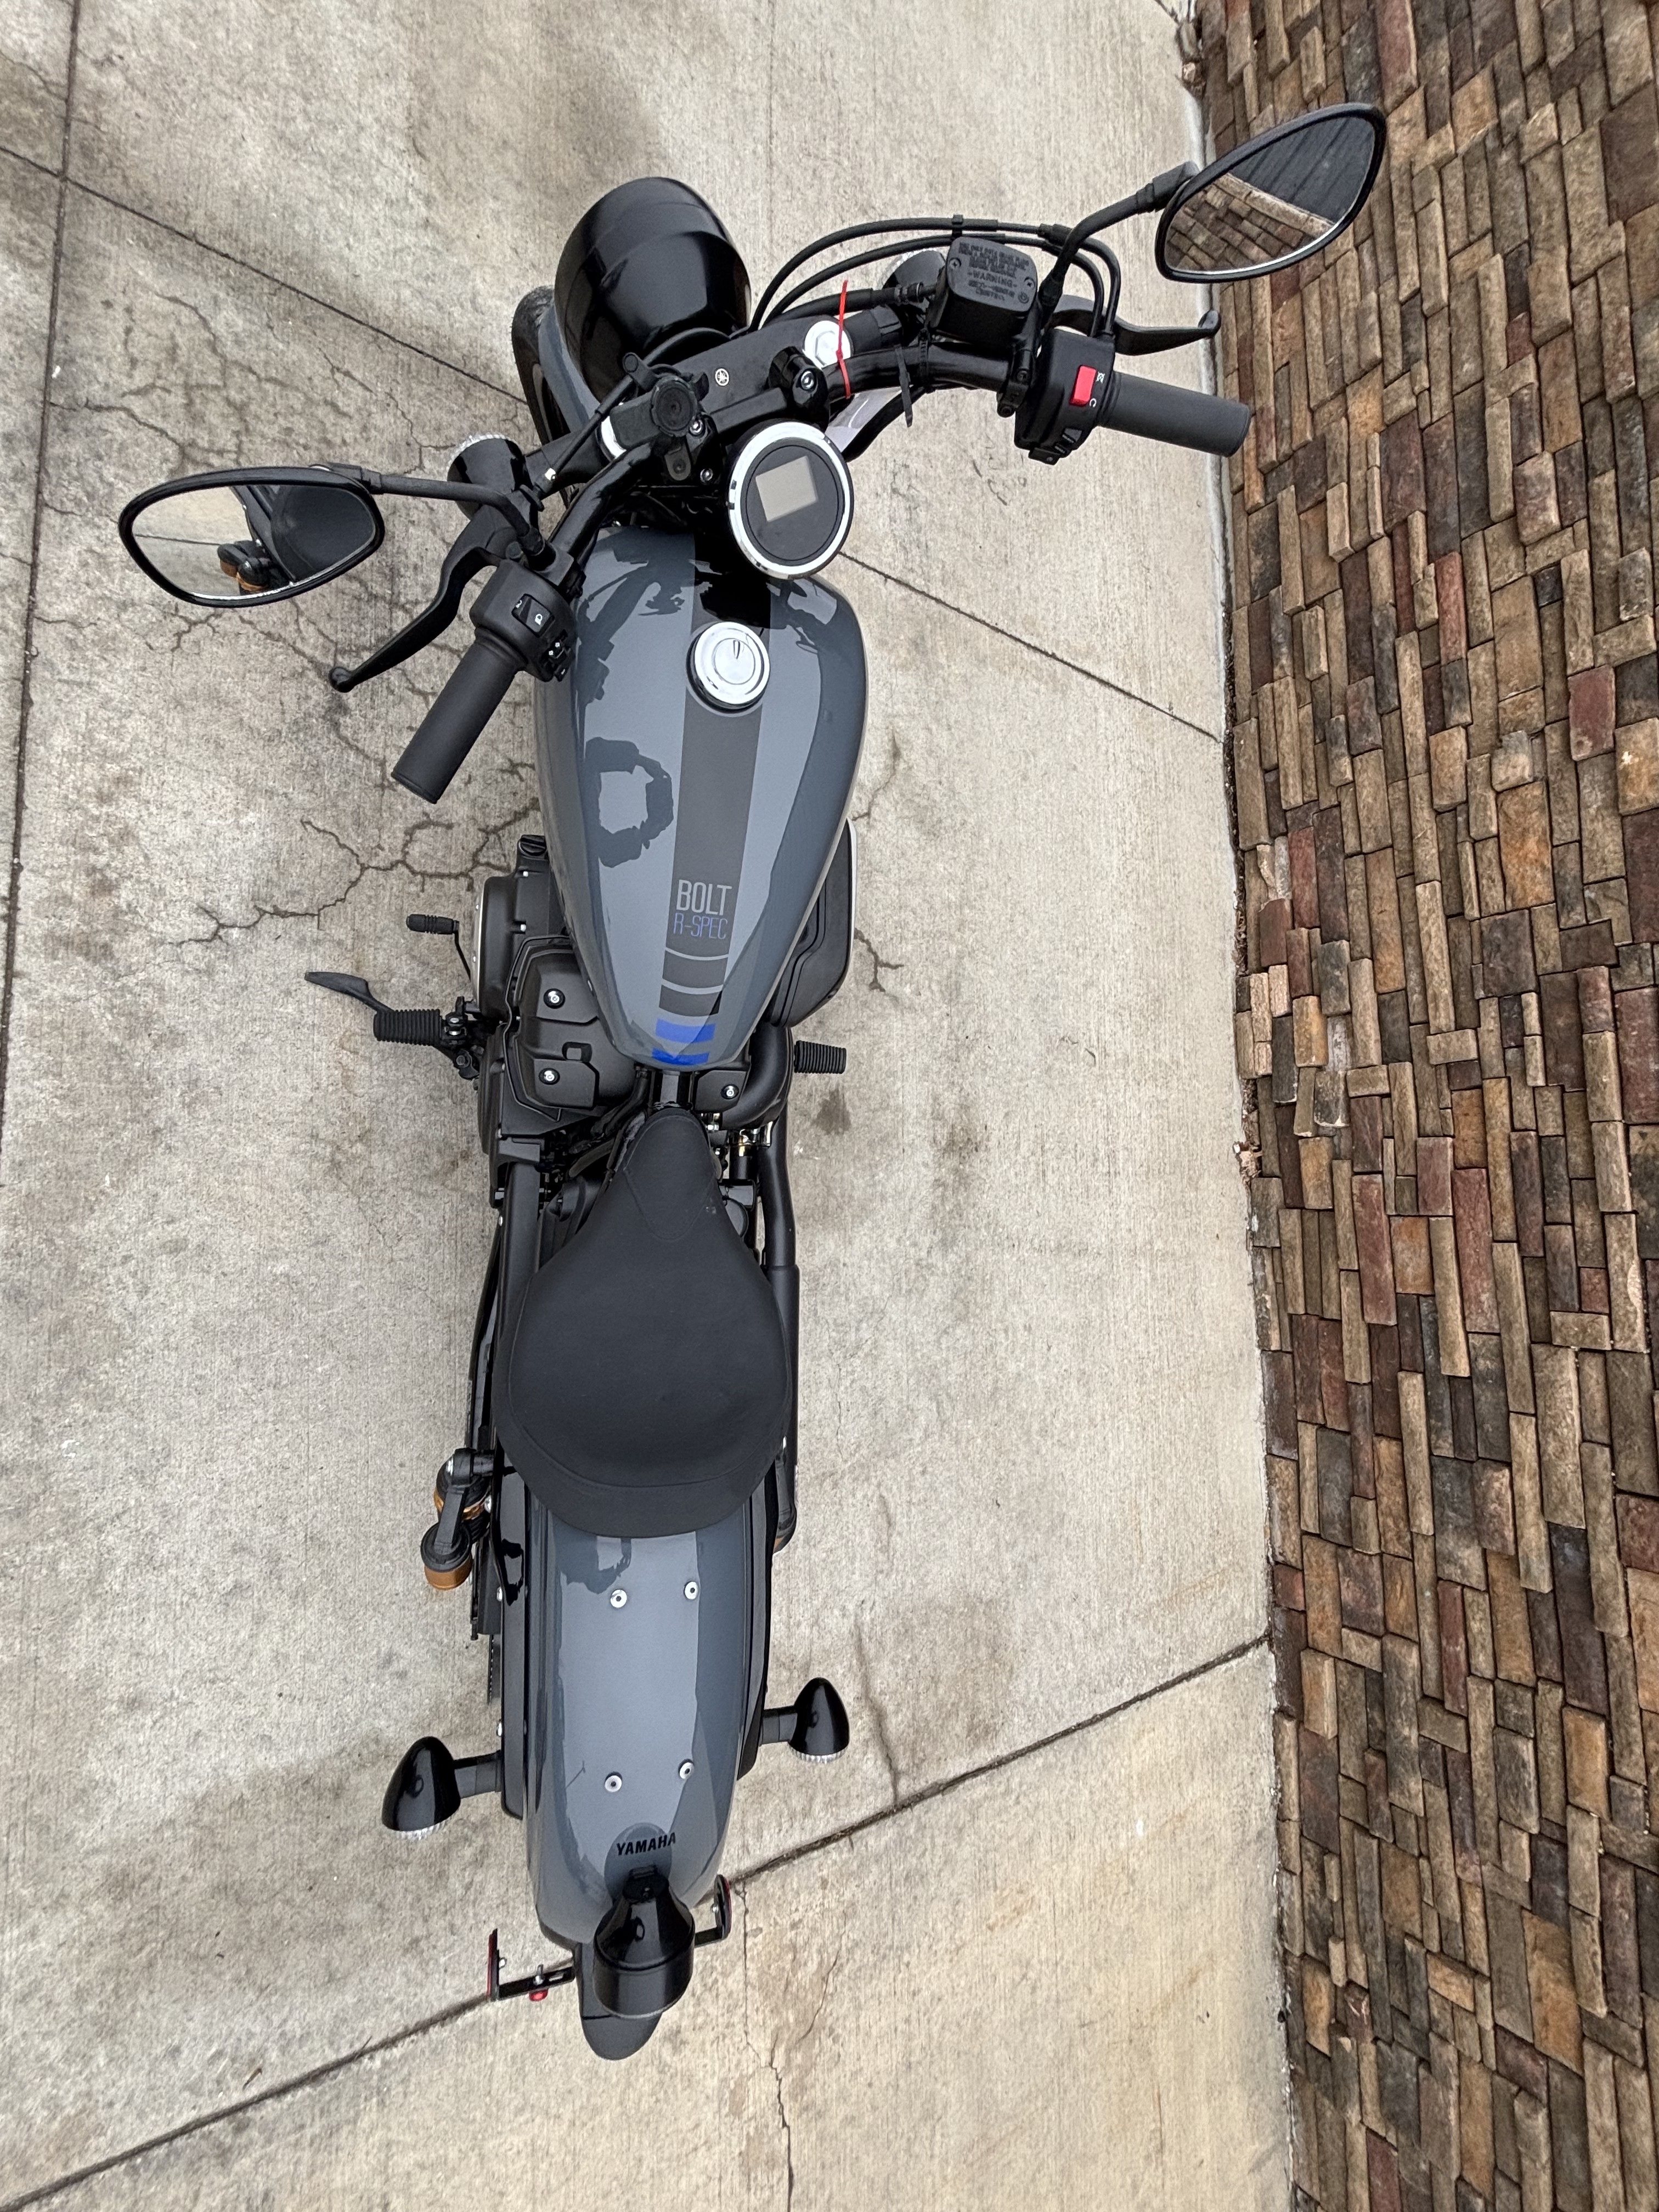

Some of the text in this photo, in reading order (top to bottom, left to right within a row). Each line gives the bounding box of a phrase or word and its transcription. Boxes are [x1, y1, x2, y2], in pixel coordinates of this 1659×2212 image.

[676, 879, 732, 916] BOLT
[673, 912, 728, 940] R-SPEC
[617, 1832, 676, 1857] YAMAHA
